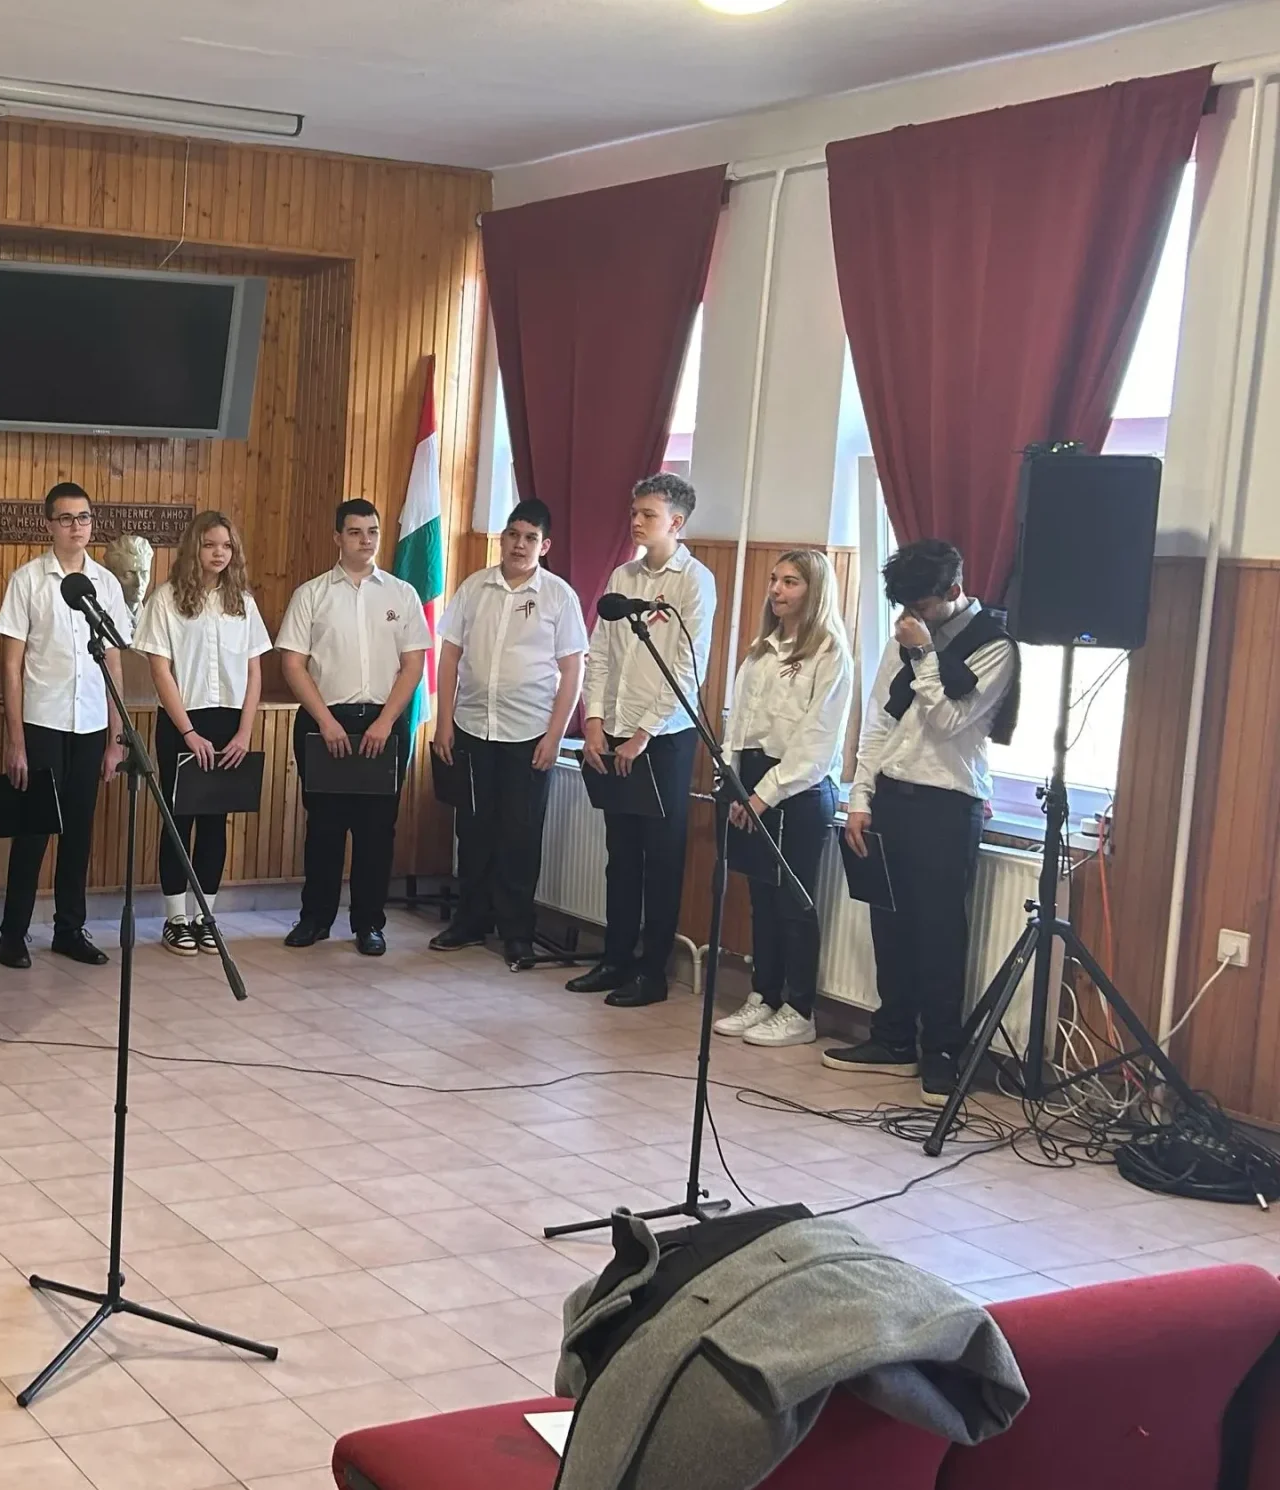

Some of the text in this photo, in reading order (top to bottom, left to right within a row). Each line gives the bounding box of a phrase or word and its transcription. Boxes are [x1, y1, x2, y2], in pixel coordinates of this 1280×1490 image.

[22, 505, 45, 516] KELL
[109, 508, 155, 519] EMBERNEK
[160, 509, 188, 520] AHHOZ
[17, 517, 46, 528] MEGTU
[122, 520, 157, 531] KEVESET
[161, 521, 170, 531] IS
